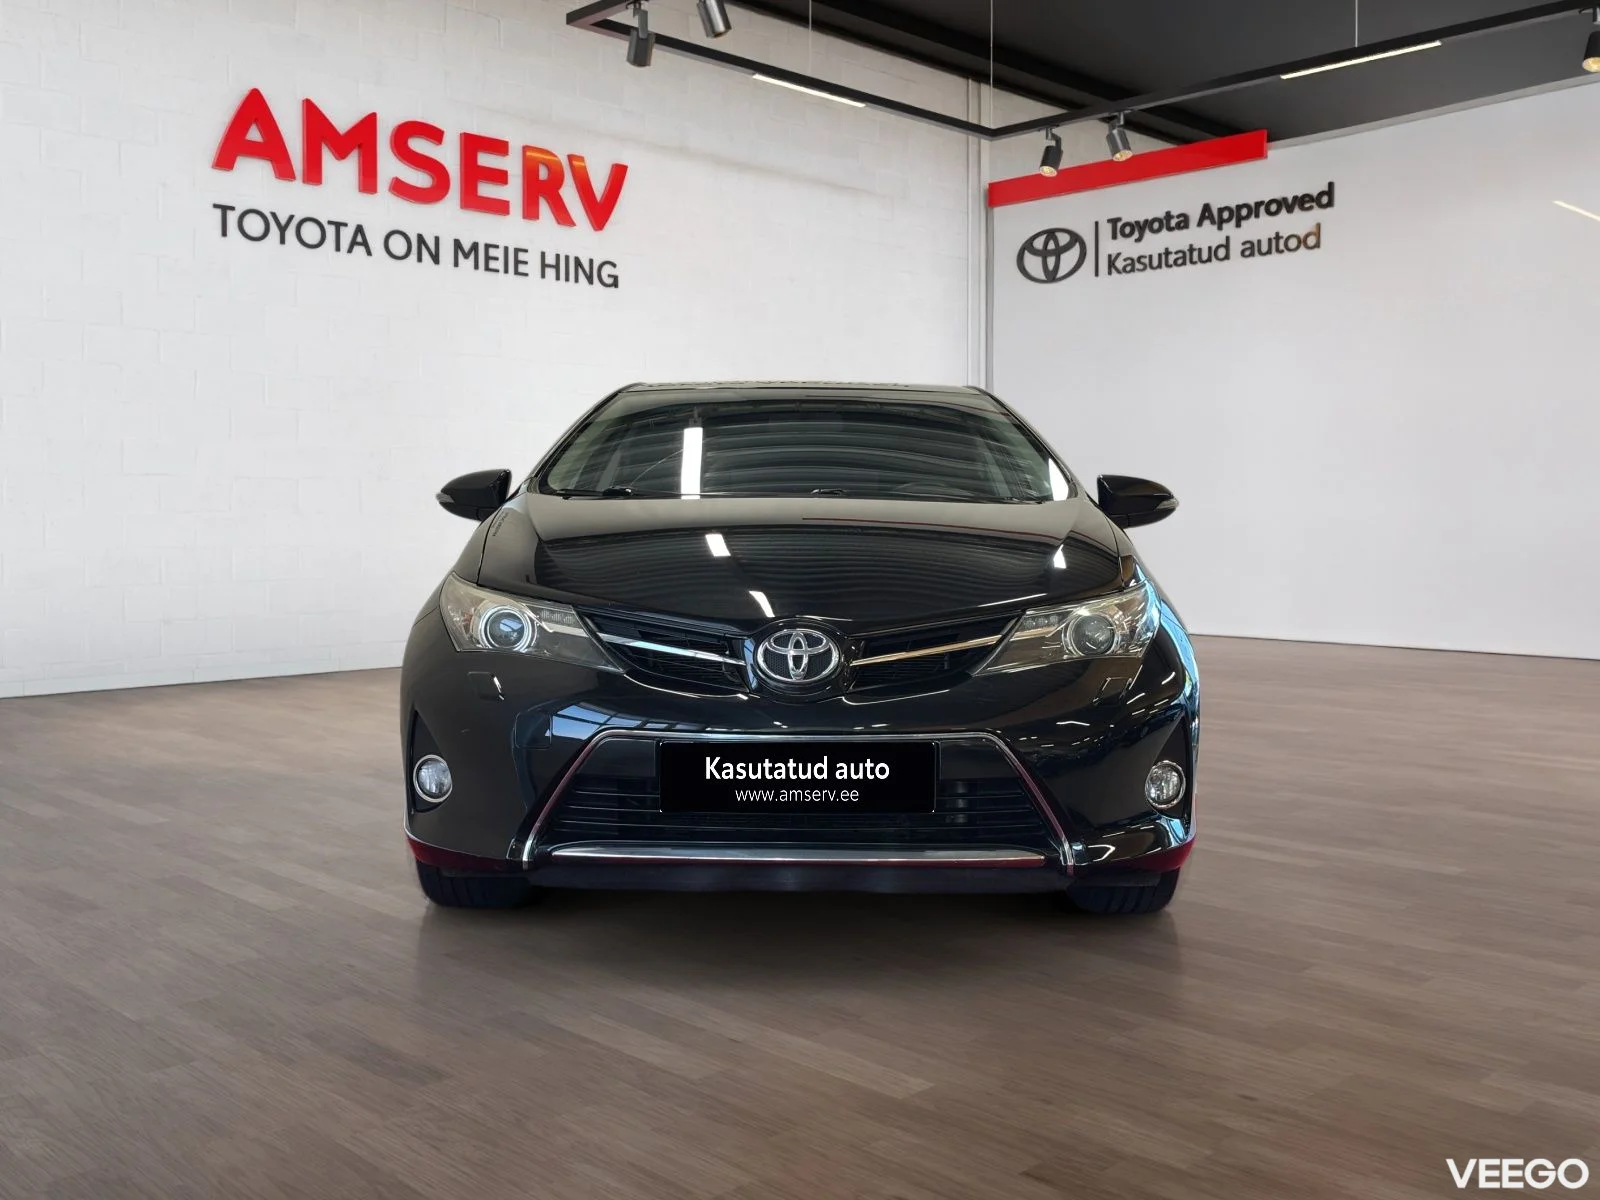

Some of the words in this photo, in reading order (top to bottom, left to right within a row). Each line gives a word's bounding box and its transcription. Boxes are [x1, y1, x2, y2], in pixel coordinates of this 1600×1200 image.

[212, 87, 629, 232] AMSERV
[1107, 211, 1190, 243] Toyota
[1196, 181, 1335, 231] Approved
[212, 203, 373, 257] TOYOTA
[383, 230, 440, 265] ON
[453, 239, 530, 276] MEIE
[540, 251, 620, 289] HING
[1107, 236, 1231, 276] Kasutatud
[1240, 222, 1322, 259] autod
[705, 756, 828, 780] Kasutatud
[835, 758, 890, 780] auto
[735, 789, 859, 803] www.amserv.ee
